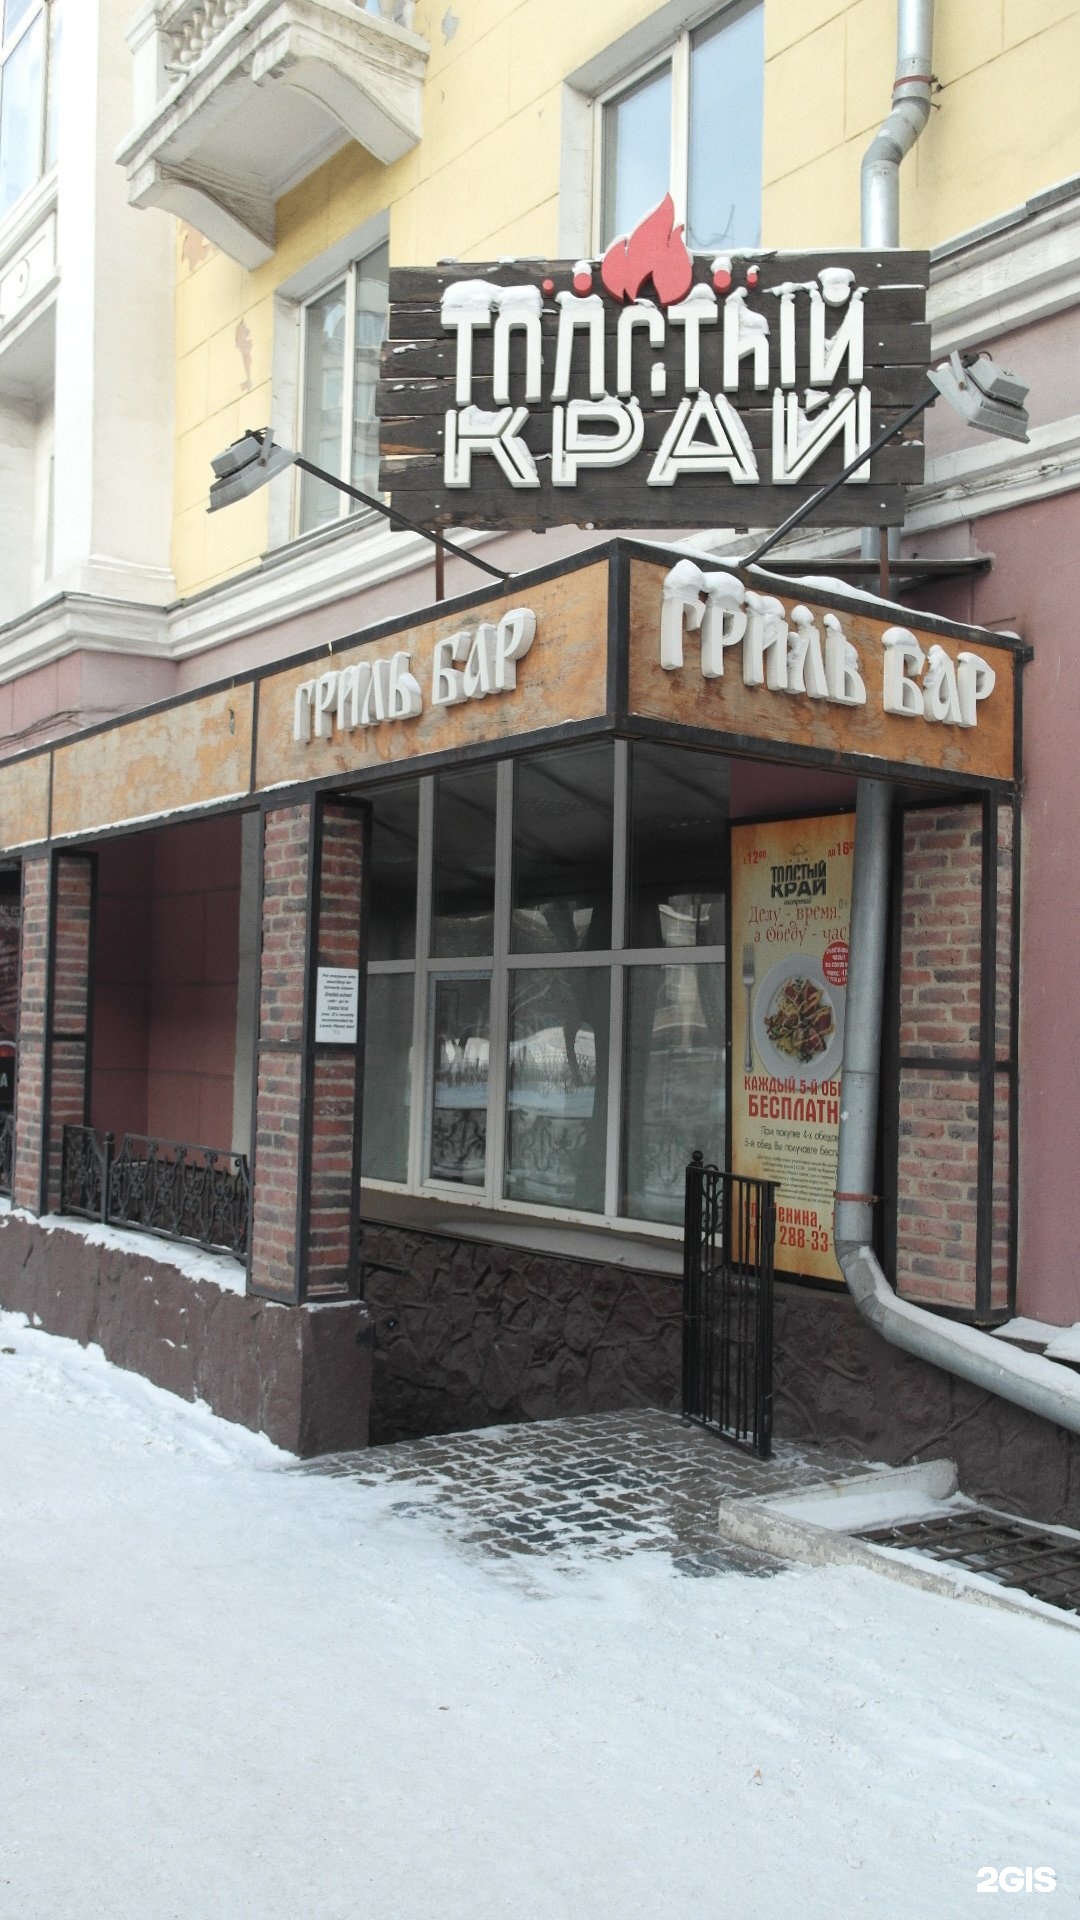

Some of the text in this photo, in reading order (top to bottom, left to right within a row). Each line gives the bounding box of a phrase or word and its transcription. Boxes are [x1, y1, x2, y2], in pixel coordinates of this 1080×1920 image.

[441, 272, 866, 406] ТОЛСТЫЙ
[443, 386, 872, 489] КРАЙ
[660, 564, 996, 728] ГРИЛЬ БАР
[293, 608, 537, 744] ГРИЛЬ БАР
[770, 861, 827, 883] ТОЛСТЫЙ
[771, 880, 827, 898] КРАЙ
[749, 906, 781, 926] Делу
[754, 931, 761, 943] а
[823, 927, 847, 942] час
[744, 1076, 796, 1094] КАЖДЫЙ
[761, 1125, 774, 1137] При
[776, 1128, 800, 1141] покупке
[756, 1140, 773, 1151] обед
[772, 1202, 823, 1232] енина,
